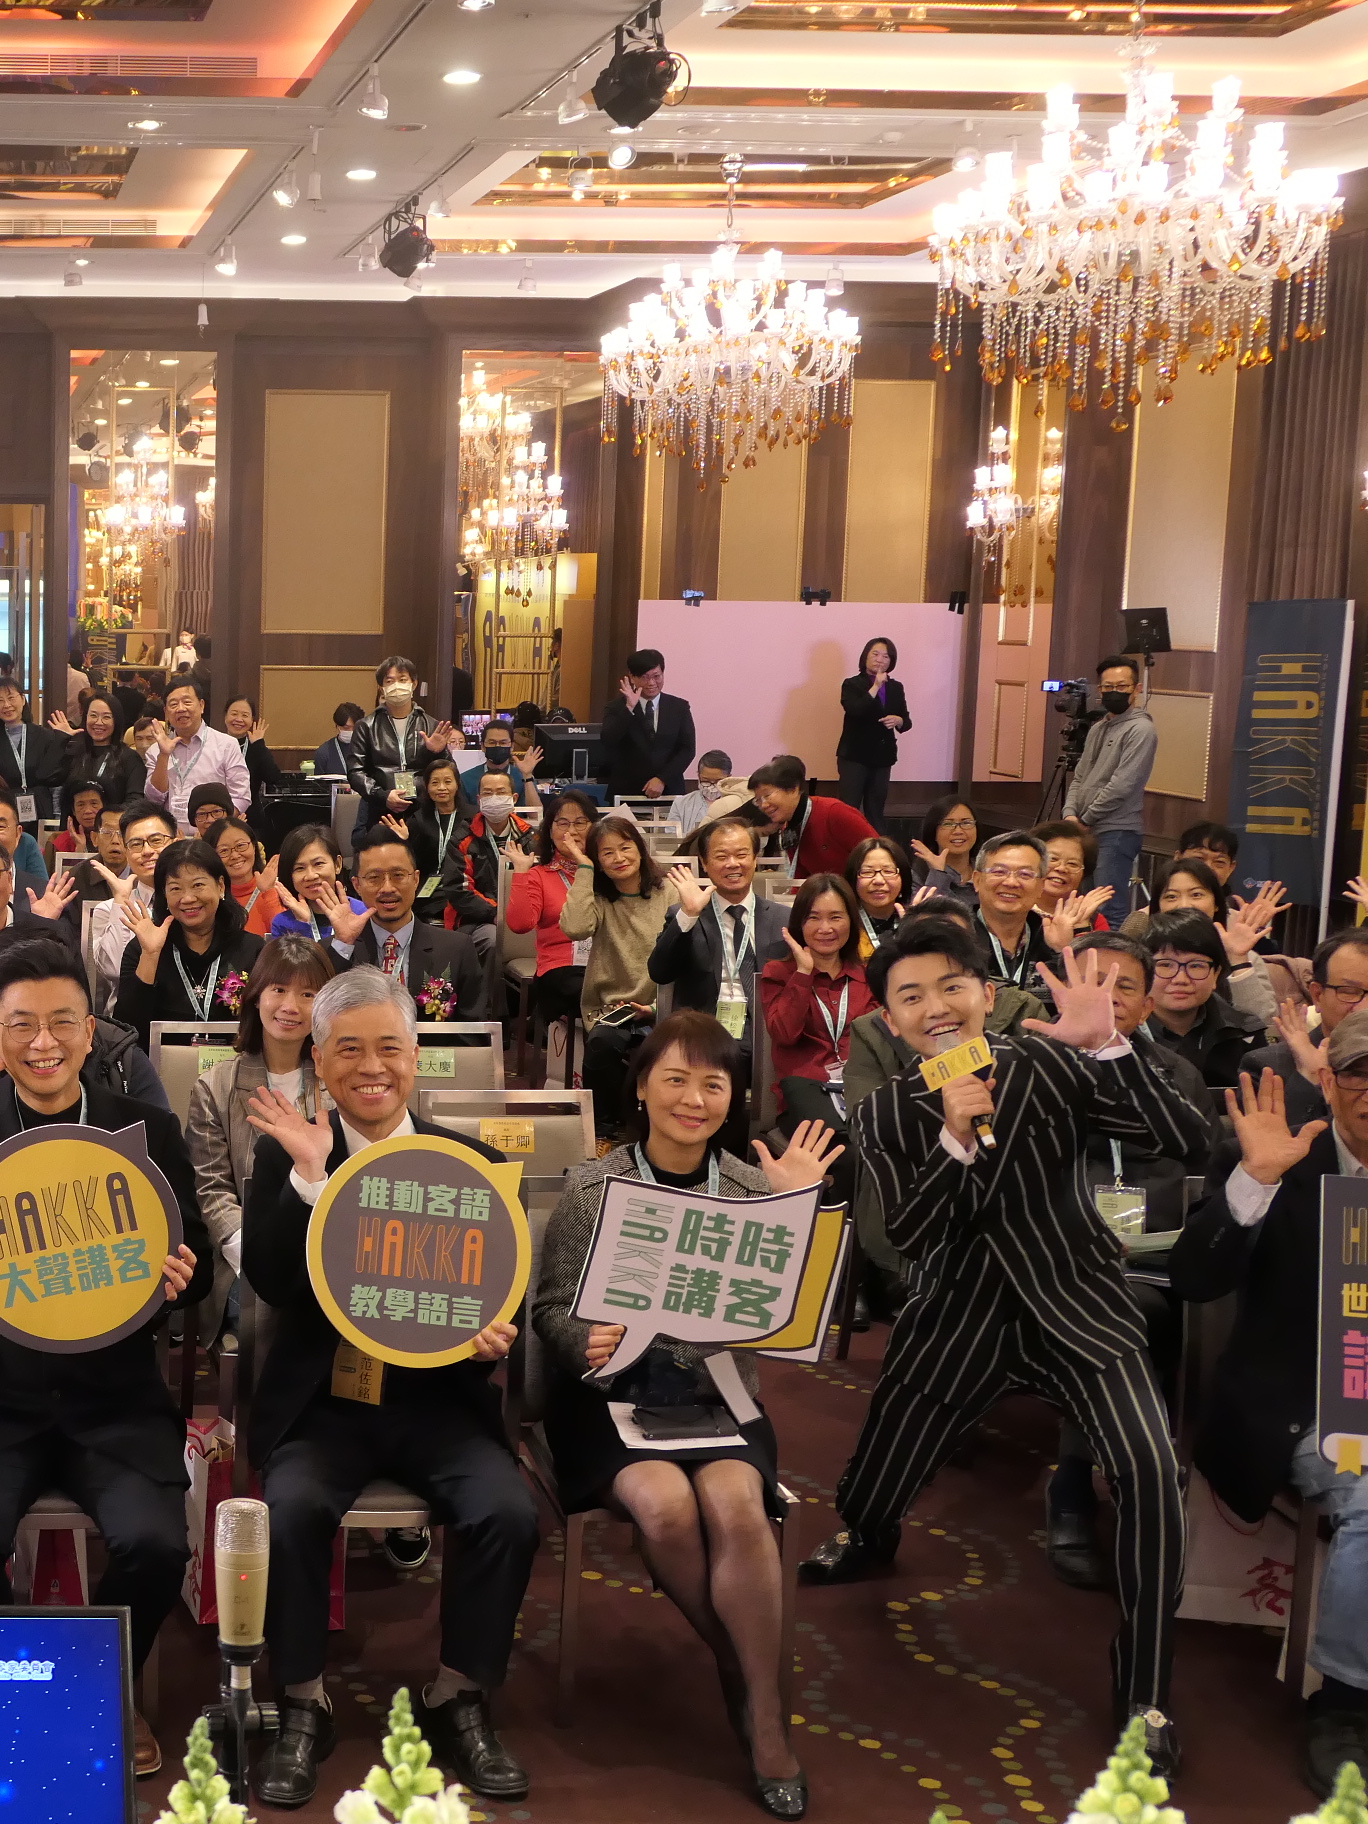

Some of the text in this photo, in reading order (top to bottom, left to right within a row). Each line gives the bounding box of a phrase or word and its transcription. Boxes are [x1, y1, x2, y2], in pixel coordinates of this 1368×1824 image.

[568, 726, 588, 734] DELL
[1245, 653, 1322, 836] HAKKA
[358, 1176, 491, 1221] 推動客語
[356, 1217, 483, 1285] HAKKA
[602, 1197, 676, 1311] HAKKA
[676, 1209, 795, 1275] 時時
[349, 1285, 483, 1330] 教學語言
[662, 1263, 782, 1330] 講客
